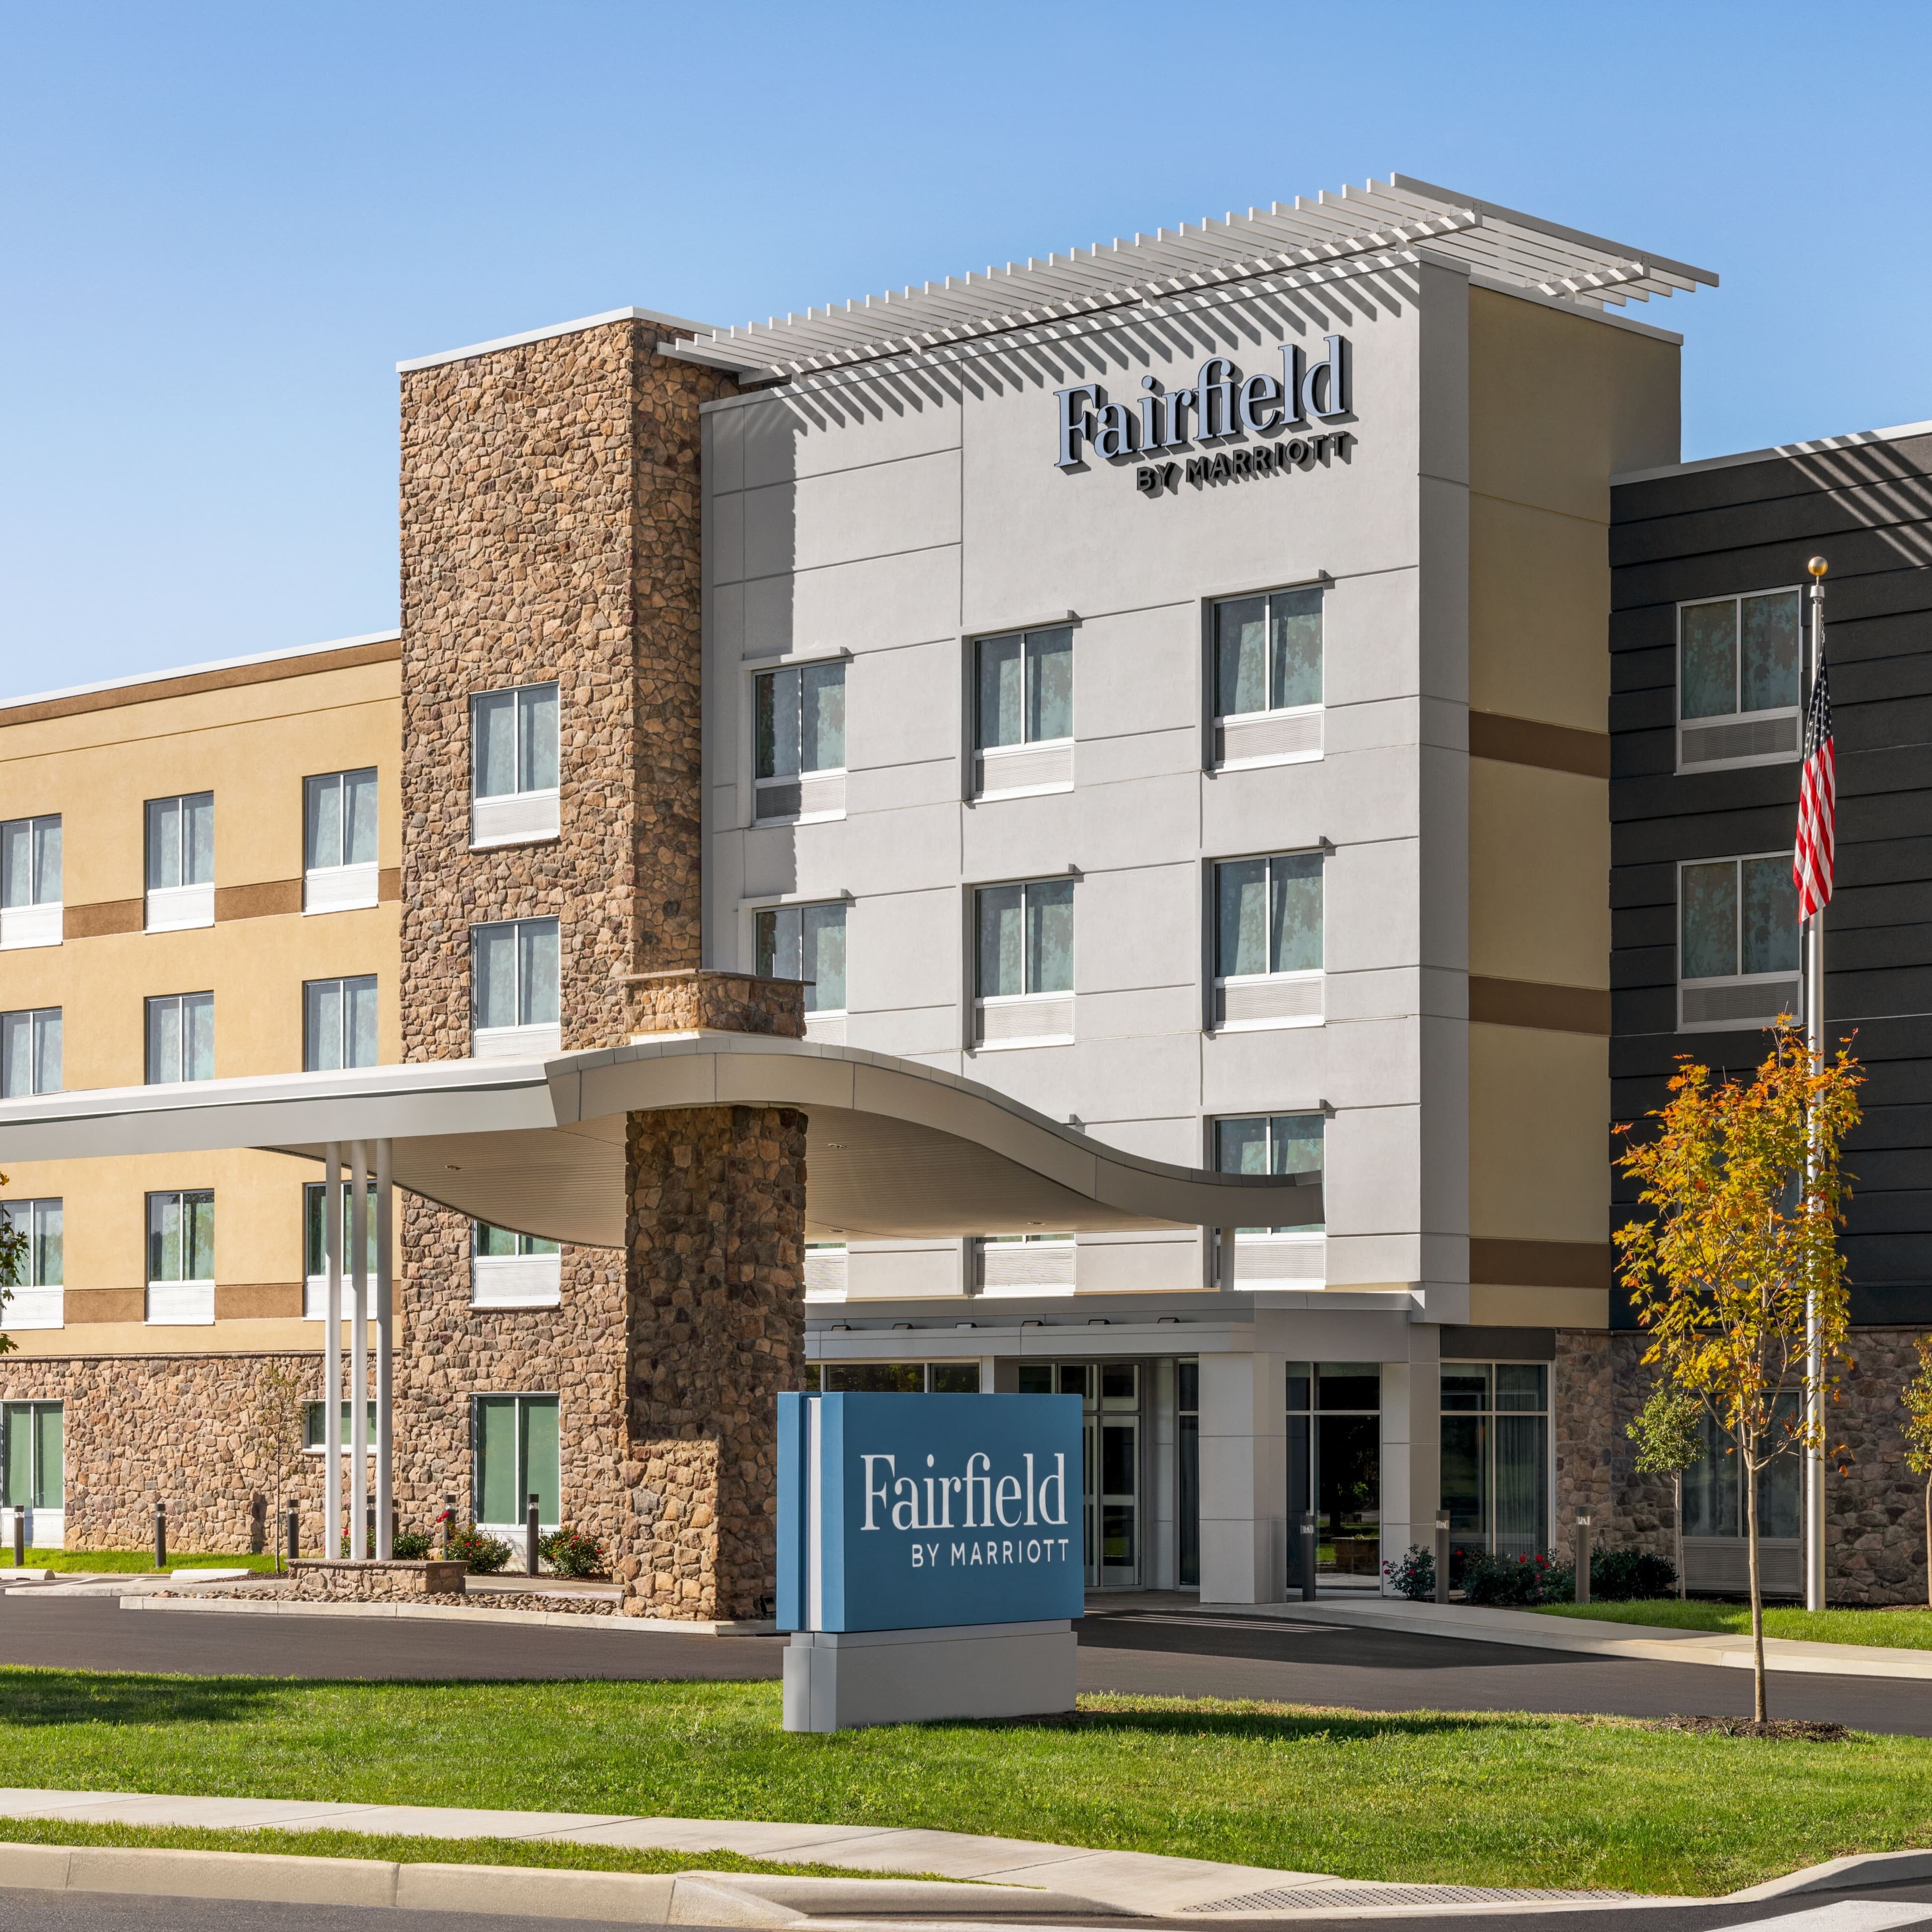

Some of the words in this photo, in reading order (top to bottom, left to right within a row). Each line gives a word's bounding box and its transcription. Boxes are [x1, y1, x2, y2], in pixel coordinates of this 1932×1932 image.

[1053, 334, 1350, 467] Fairfield
[1137, 462, 1175, 491] BY
[1185, 431, 1349, 483] MARRIOTT
[860, 1452, 1069, 1531] Fairfield
[912, 1543, 940, 1568] BY
[951, 1539, 1069, 1566] MARRIOTT
